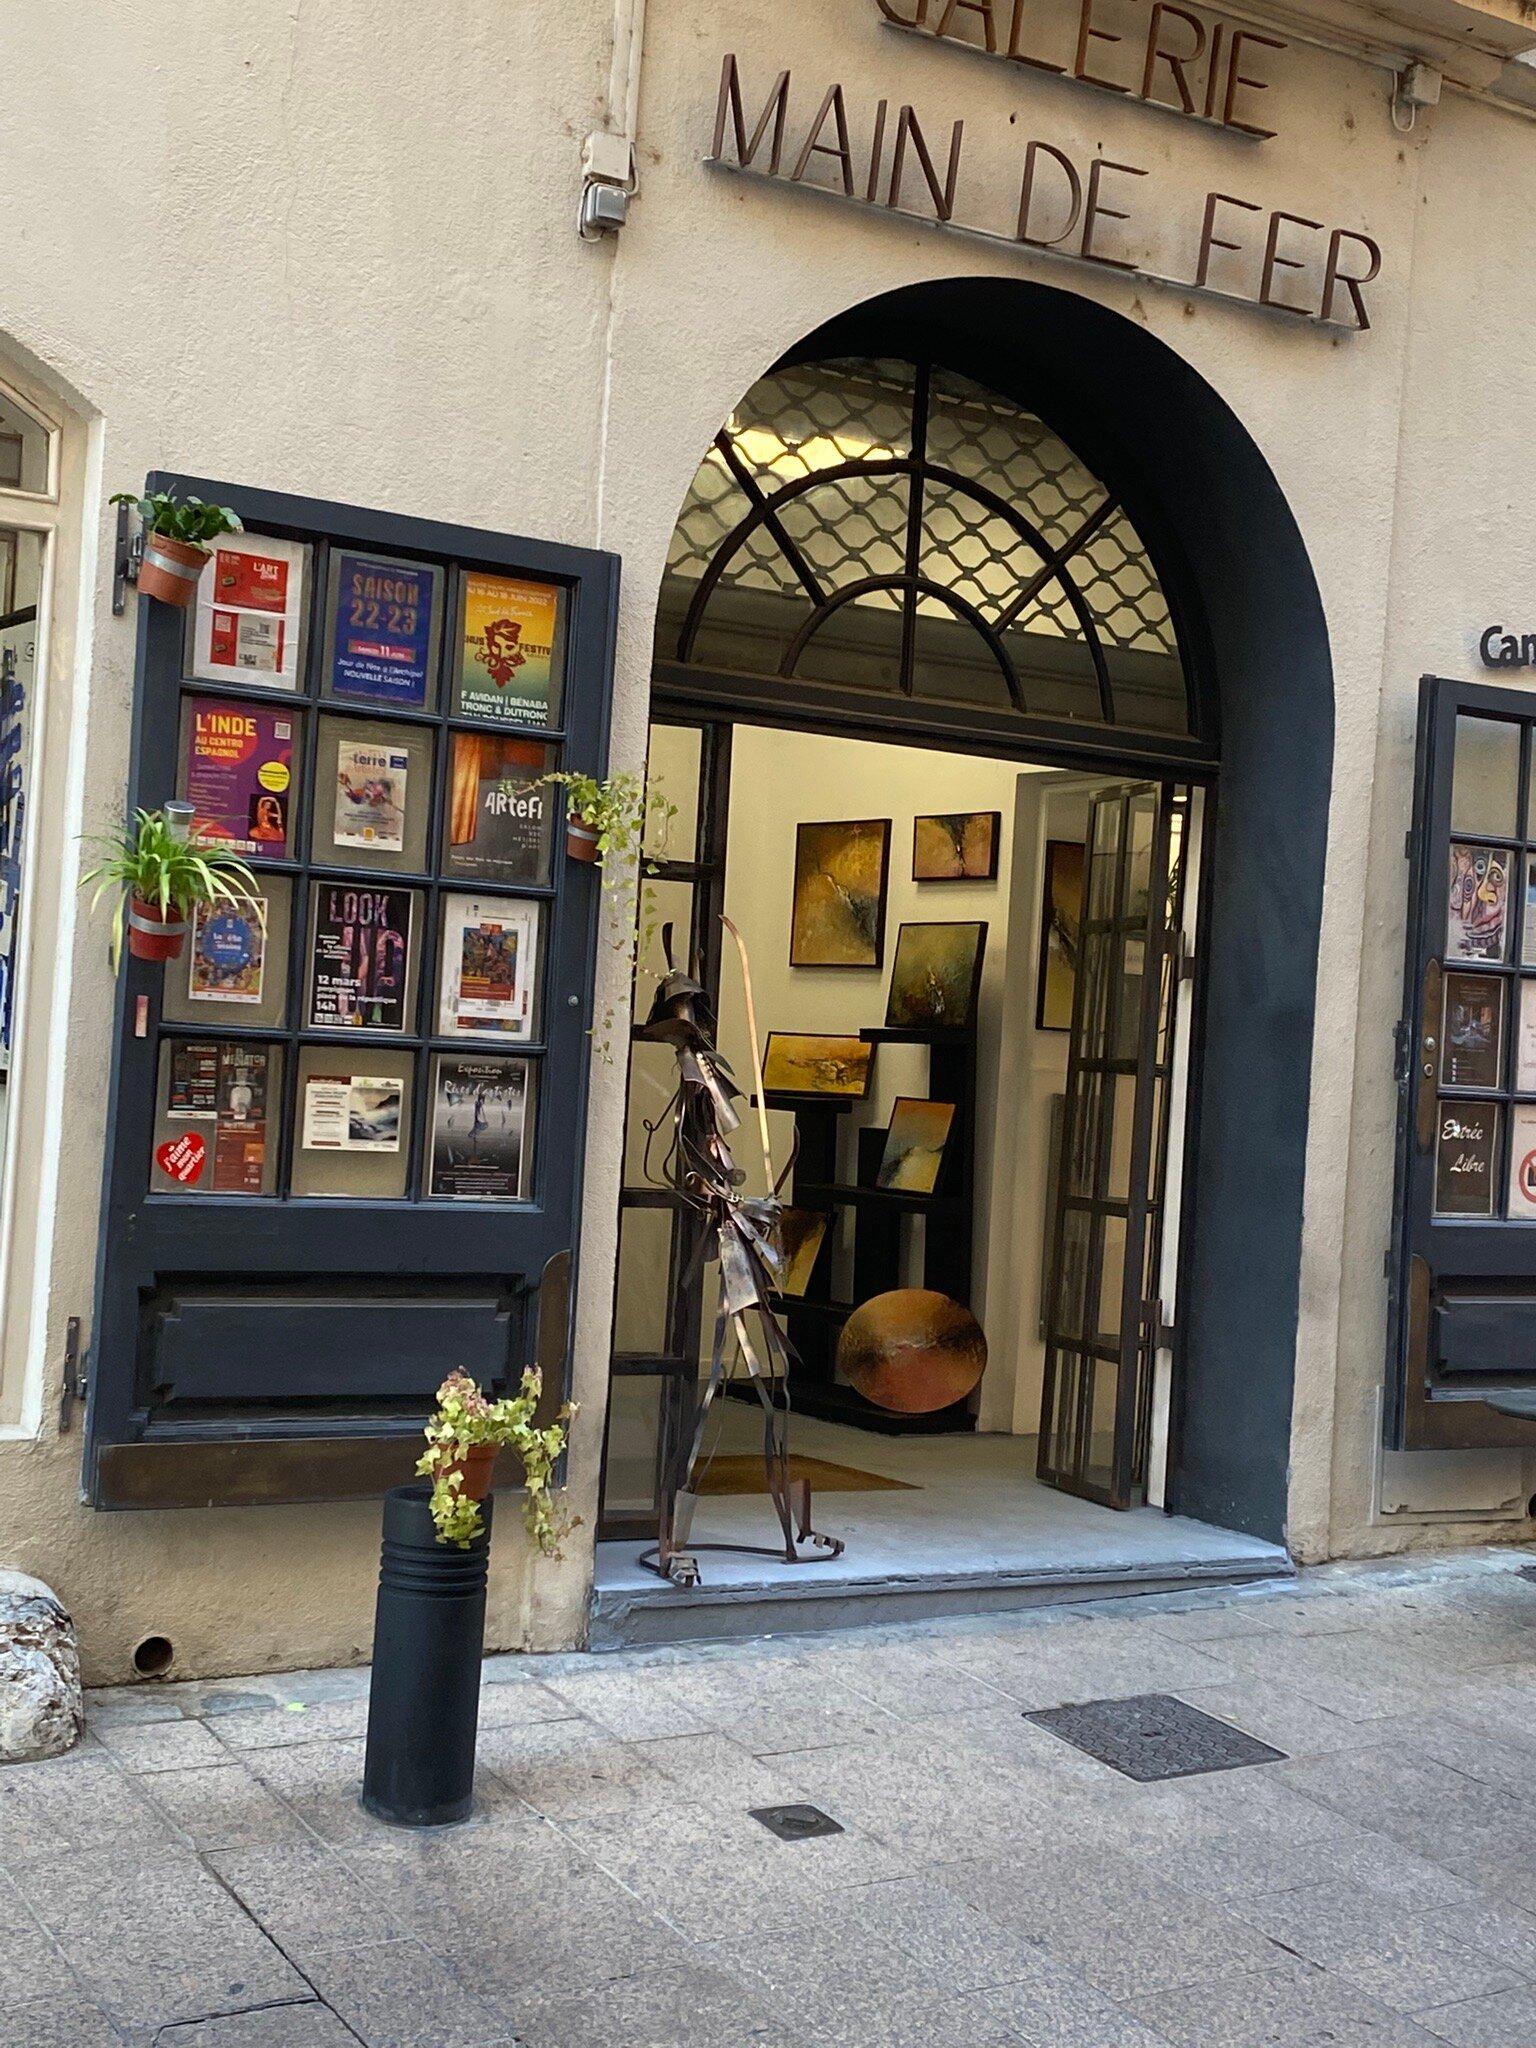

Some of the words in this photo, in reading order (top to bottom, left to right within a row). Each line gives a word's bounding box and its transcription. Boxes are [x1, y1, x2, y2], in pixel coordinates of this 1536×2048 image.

[875, 0, 1288, 140] ALERIE
[712, 53, 963, 221] MAIN
[1016, 141, 1149, 270] DE
[1199, 192, 1382, 331] FER
[352, 573, 419, 606] SAISON
[350, 600, 418, 636] 22-23
[343, 669, 383, 683] NOUVELLE
[383, 674, 411, 687] SAISON
[461, 701, 492, 713] TRONC
[469, 692, 503, 705] AVIDAN
[195, 713, 257, 737] L'INDE
[195, 735, 207, 745] AU
[209, 737, 244, 749] CENTRO
[195, 746, 240, 759] ESPAGNOL
[330, 890, 389, 928] LOOK
[318, 975, 330, 986] 12
[331, 977, 362, 988] mars
[316, 1001, 336, 1012] 14h
[458, 1064, 503, 1075] Exposition
[163, 1136, 192, 1173] j'aime
[176, 1149, 194, 1170] mon
[178, 1146, 206, 1182] quartier
[1450, 1153, 1486, 1173] Libre
